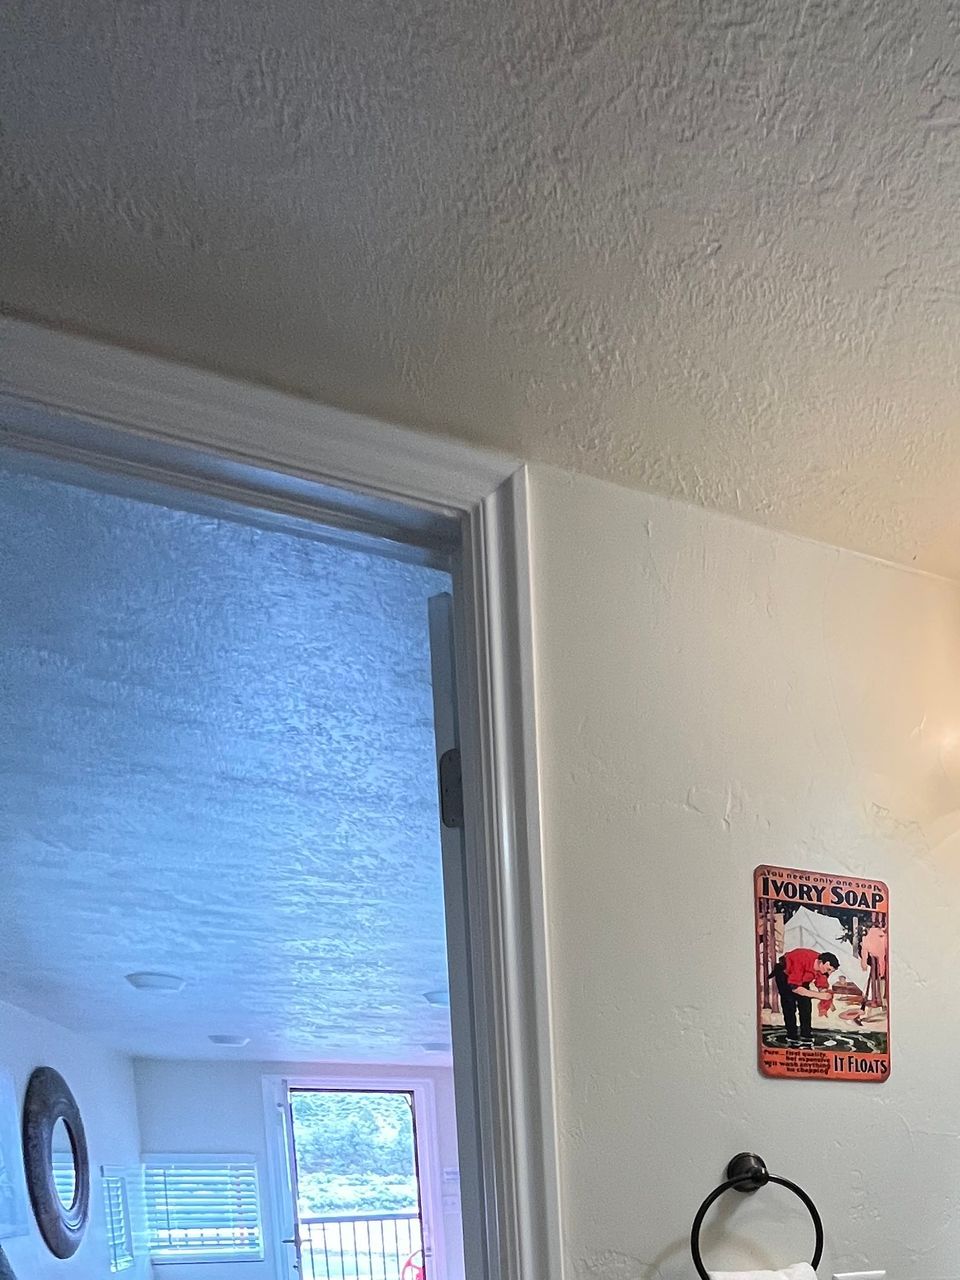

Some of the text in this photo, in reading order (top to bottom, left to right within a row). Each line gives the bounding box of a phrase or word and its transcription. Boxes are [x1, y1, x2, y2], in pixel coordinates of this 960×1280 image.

[786, 872, 811, 882] need
[813, 876, 834, 886] only
[836, 880, 853, 888] one
[761, 876, 885, 909] IVORY SOAP
[834, 1055, 888, 1074] IT FLOATS
